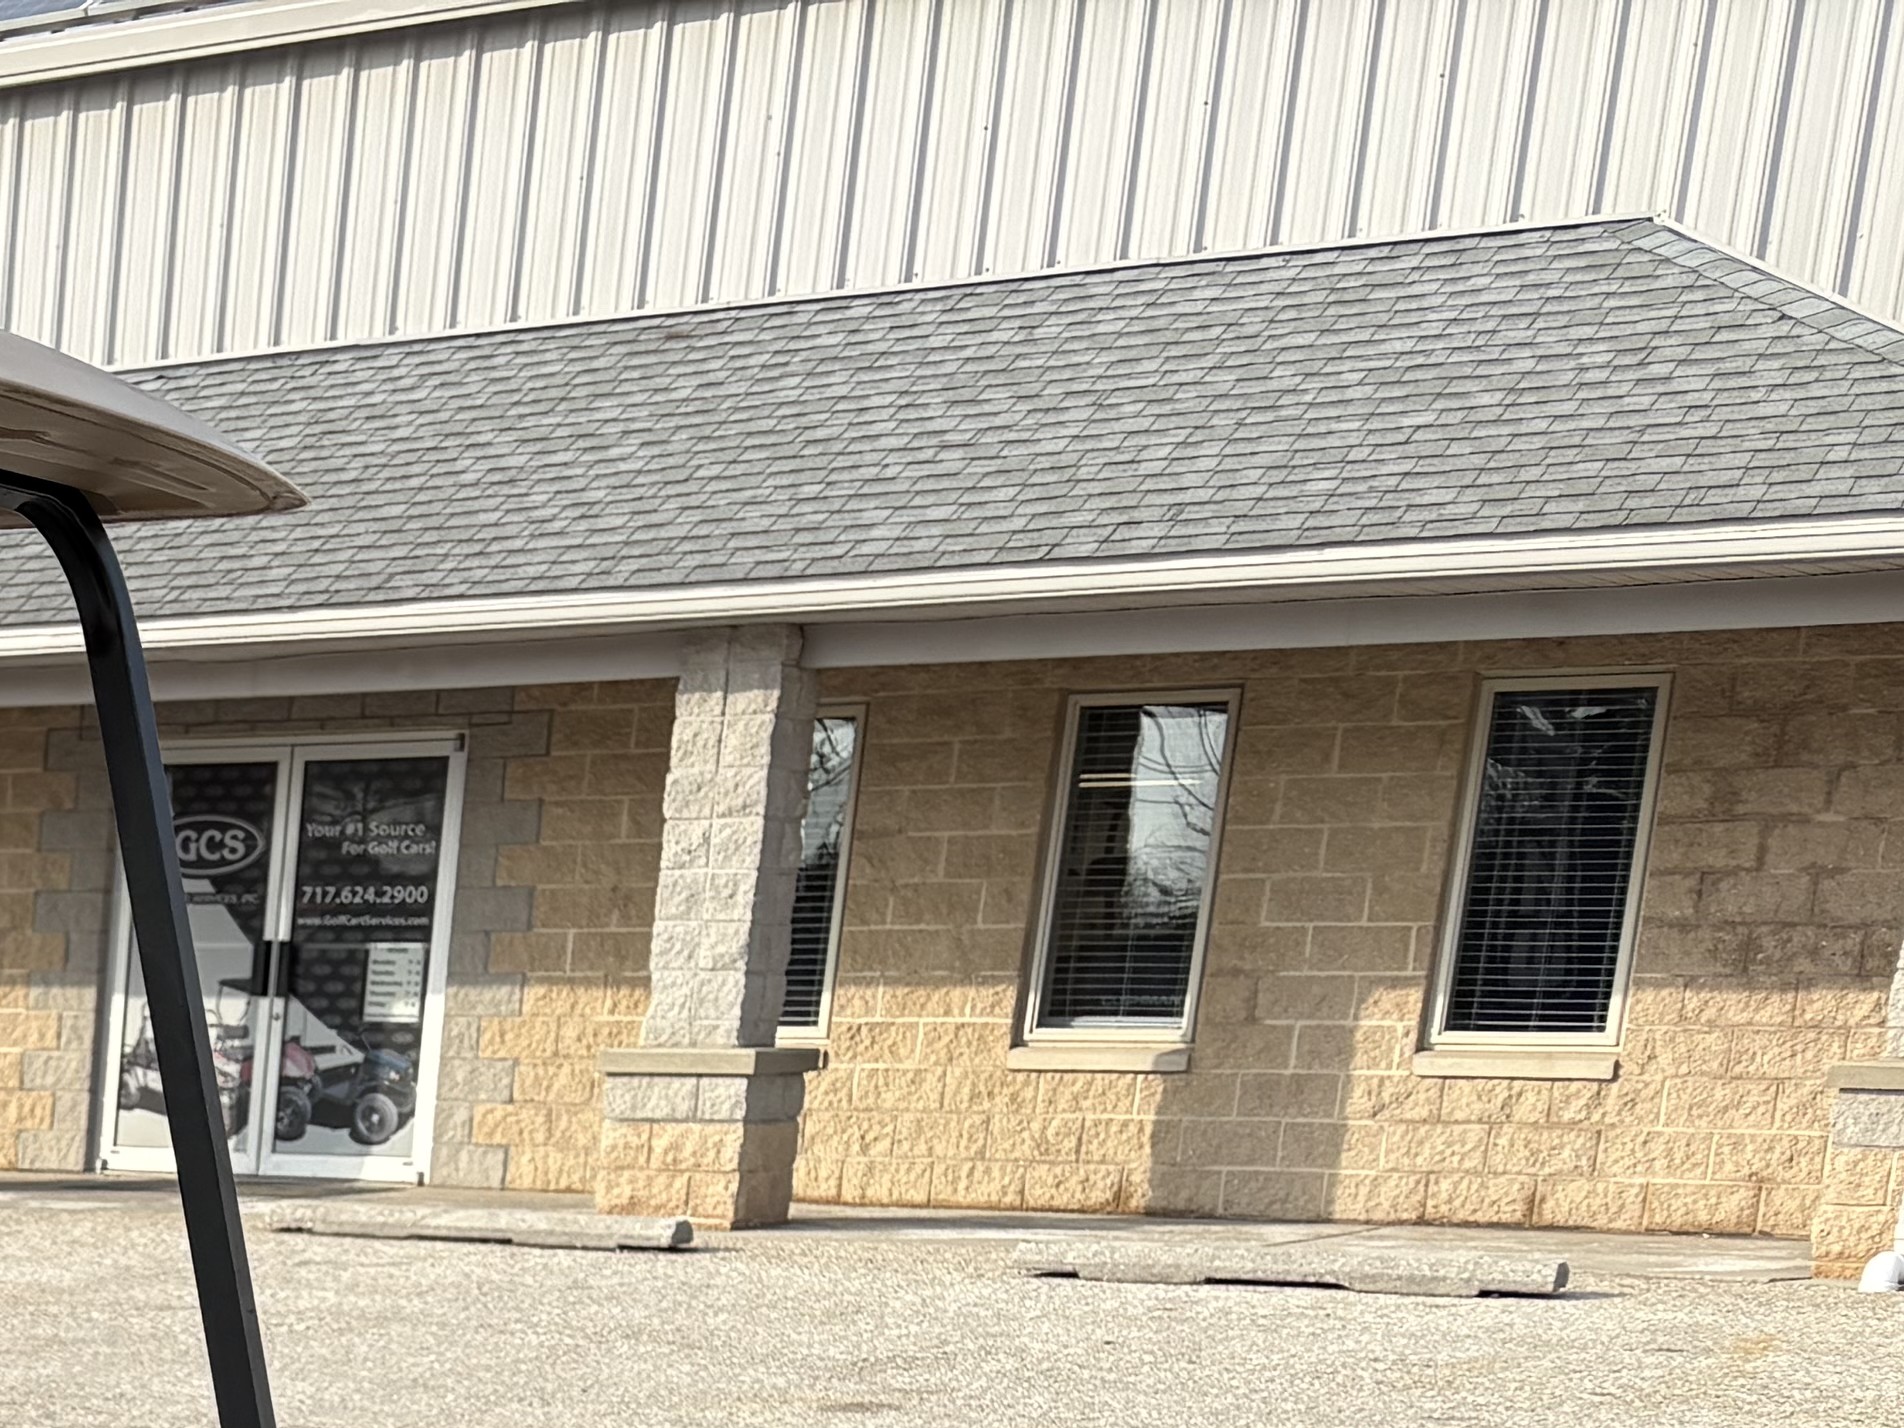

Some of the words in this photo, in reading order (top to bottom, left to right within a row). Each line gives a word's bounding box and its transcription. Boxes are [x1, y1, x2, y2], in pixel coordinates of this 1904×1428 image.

[305, 822, 342, 838] Your
[345, 822, 364, 837] #1
[368, 821, 427, 837] Source
[175, 829, 246, 862] GCS
[341, 841, 366, 855] For
[367, 839, 400, 855] Golf
[301, 885, 429, 904] 717.624.2900
